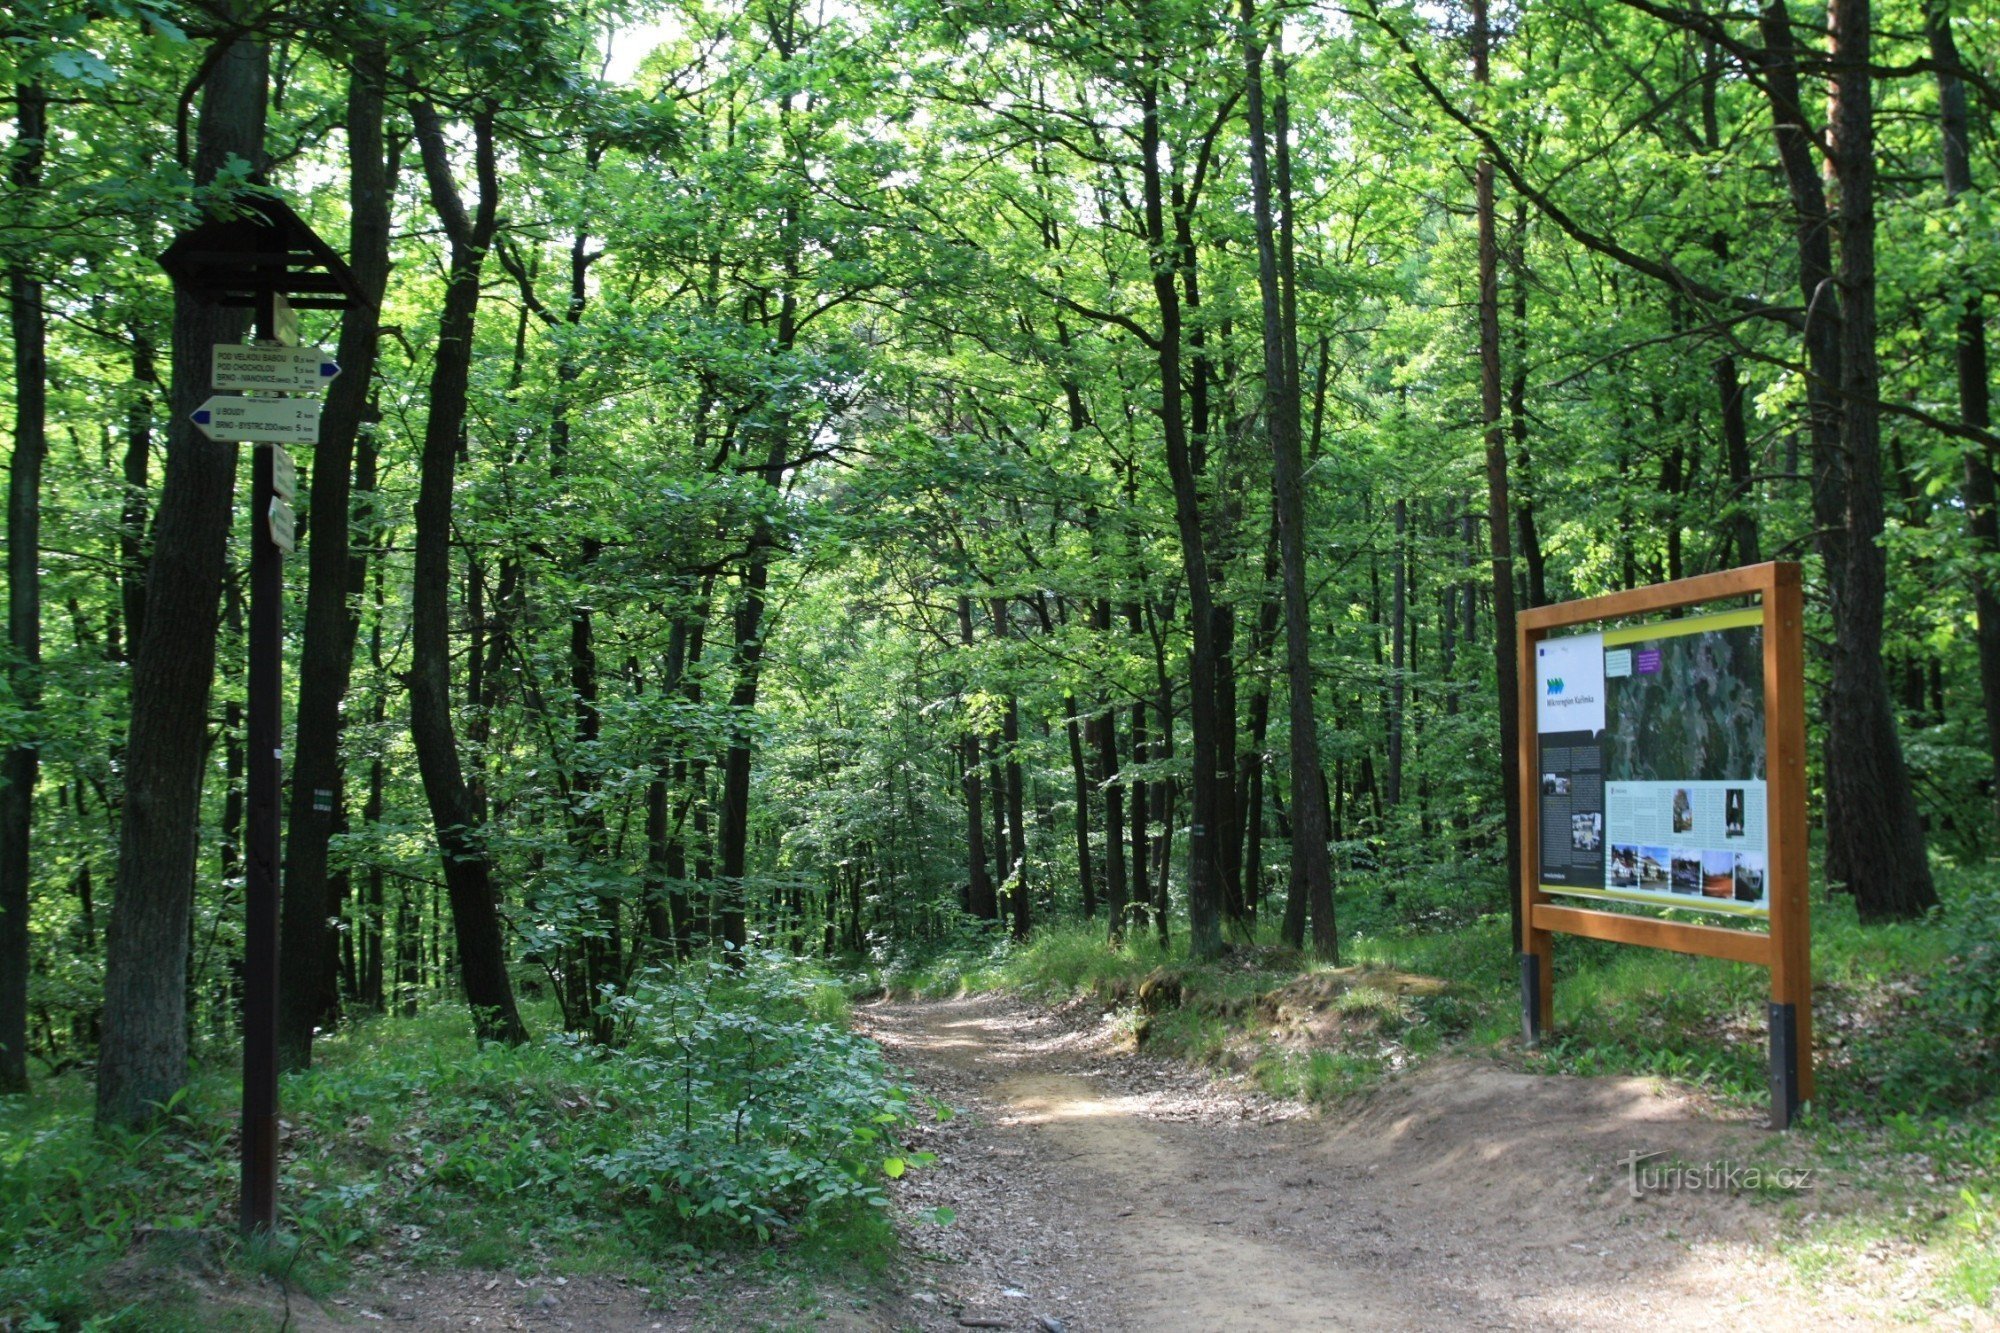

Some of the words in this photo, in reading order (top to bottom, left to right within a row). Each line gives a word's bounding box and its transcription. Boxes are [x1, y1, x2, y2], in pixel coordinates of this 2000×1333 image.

[217, 352, 232, 360] POD
[233, 353, 262, 361] VELKOU
[263, 354, 287, 362] BABOU
[217, 363, 231, 371] POD
[216, 373, 236, 381] BRNO
[293, 376, 299, 384] 3
[222, 407, 245, 416] BOUDY
[296, 410, 302, 418] 2
[215, 420, 234, 429] BRNO
[1547, 697, 1574, 707] Mikroregion
